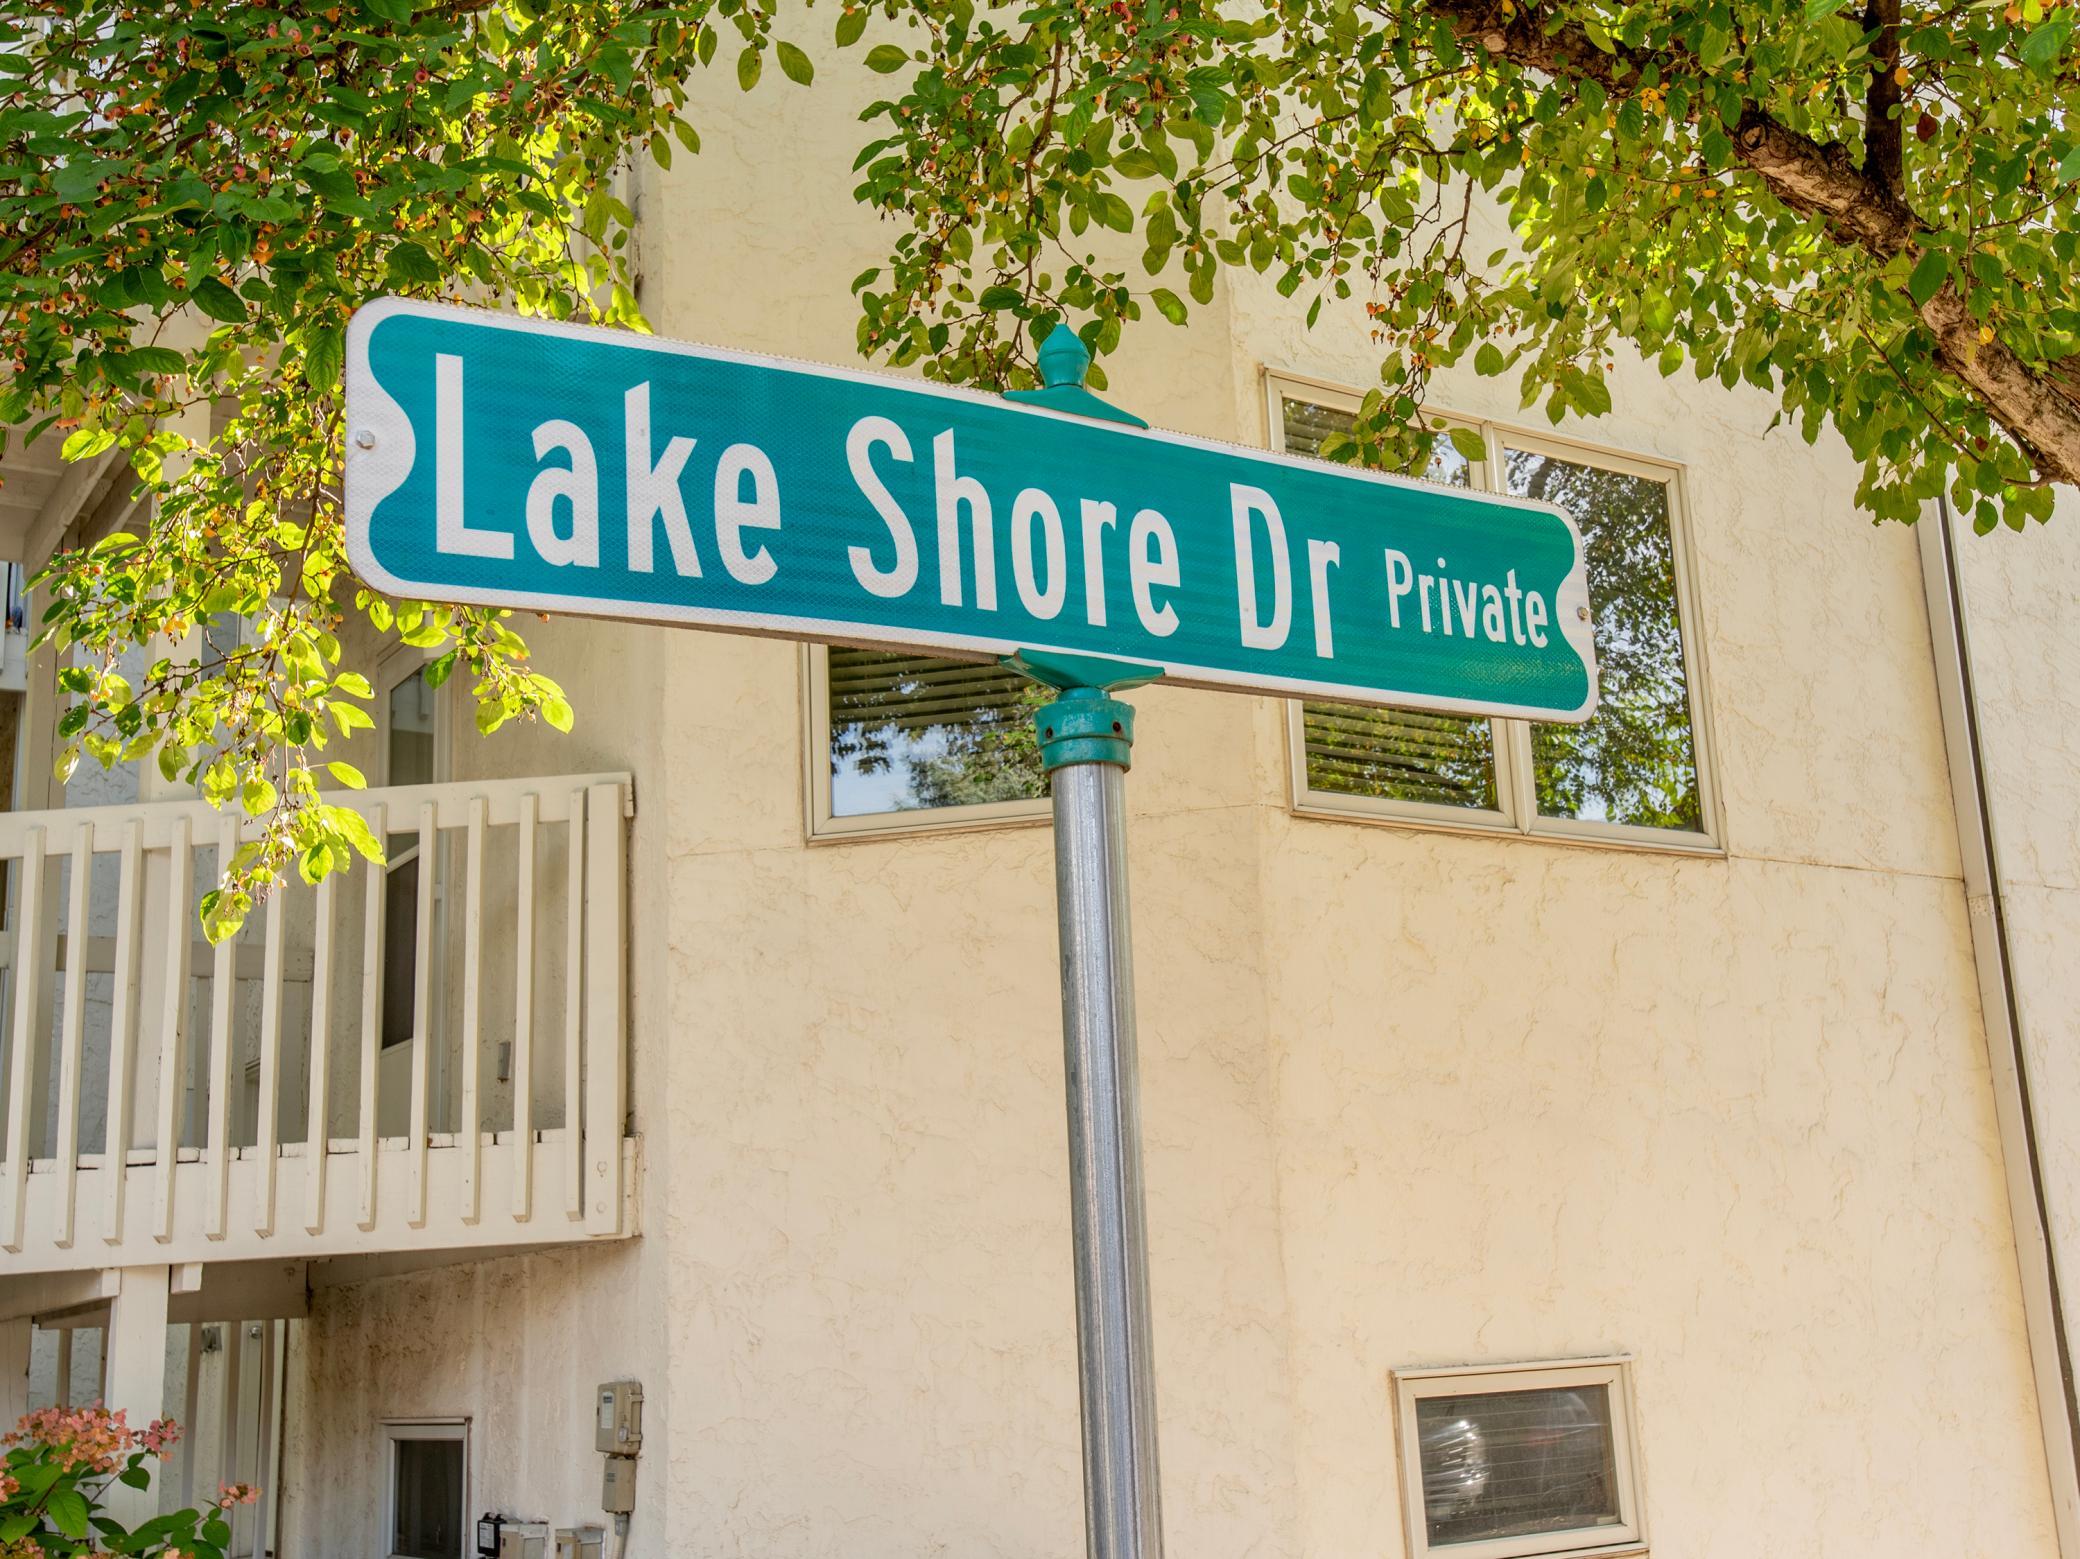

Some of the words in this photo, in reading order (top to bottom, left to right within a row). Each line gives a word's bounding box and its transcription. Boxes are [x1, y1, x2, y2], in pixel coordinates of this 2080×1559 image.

[434, 352, 781, 585] Lake
[845, 415, 1182, 638] Shore
[1229, 482, 1341, 659] Dr
[1384, 548, 1549, 649] Private
